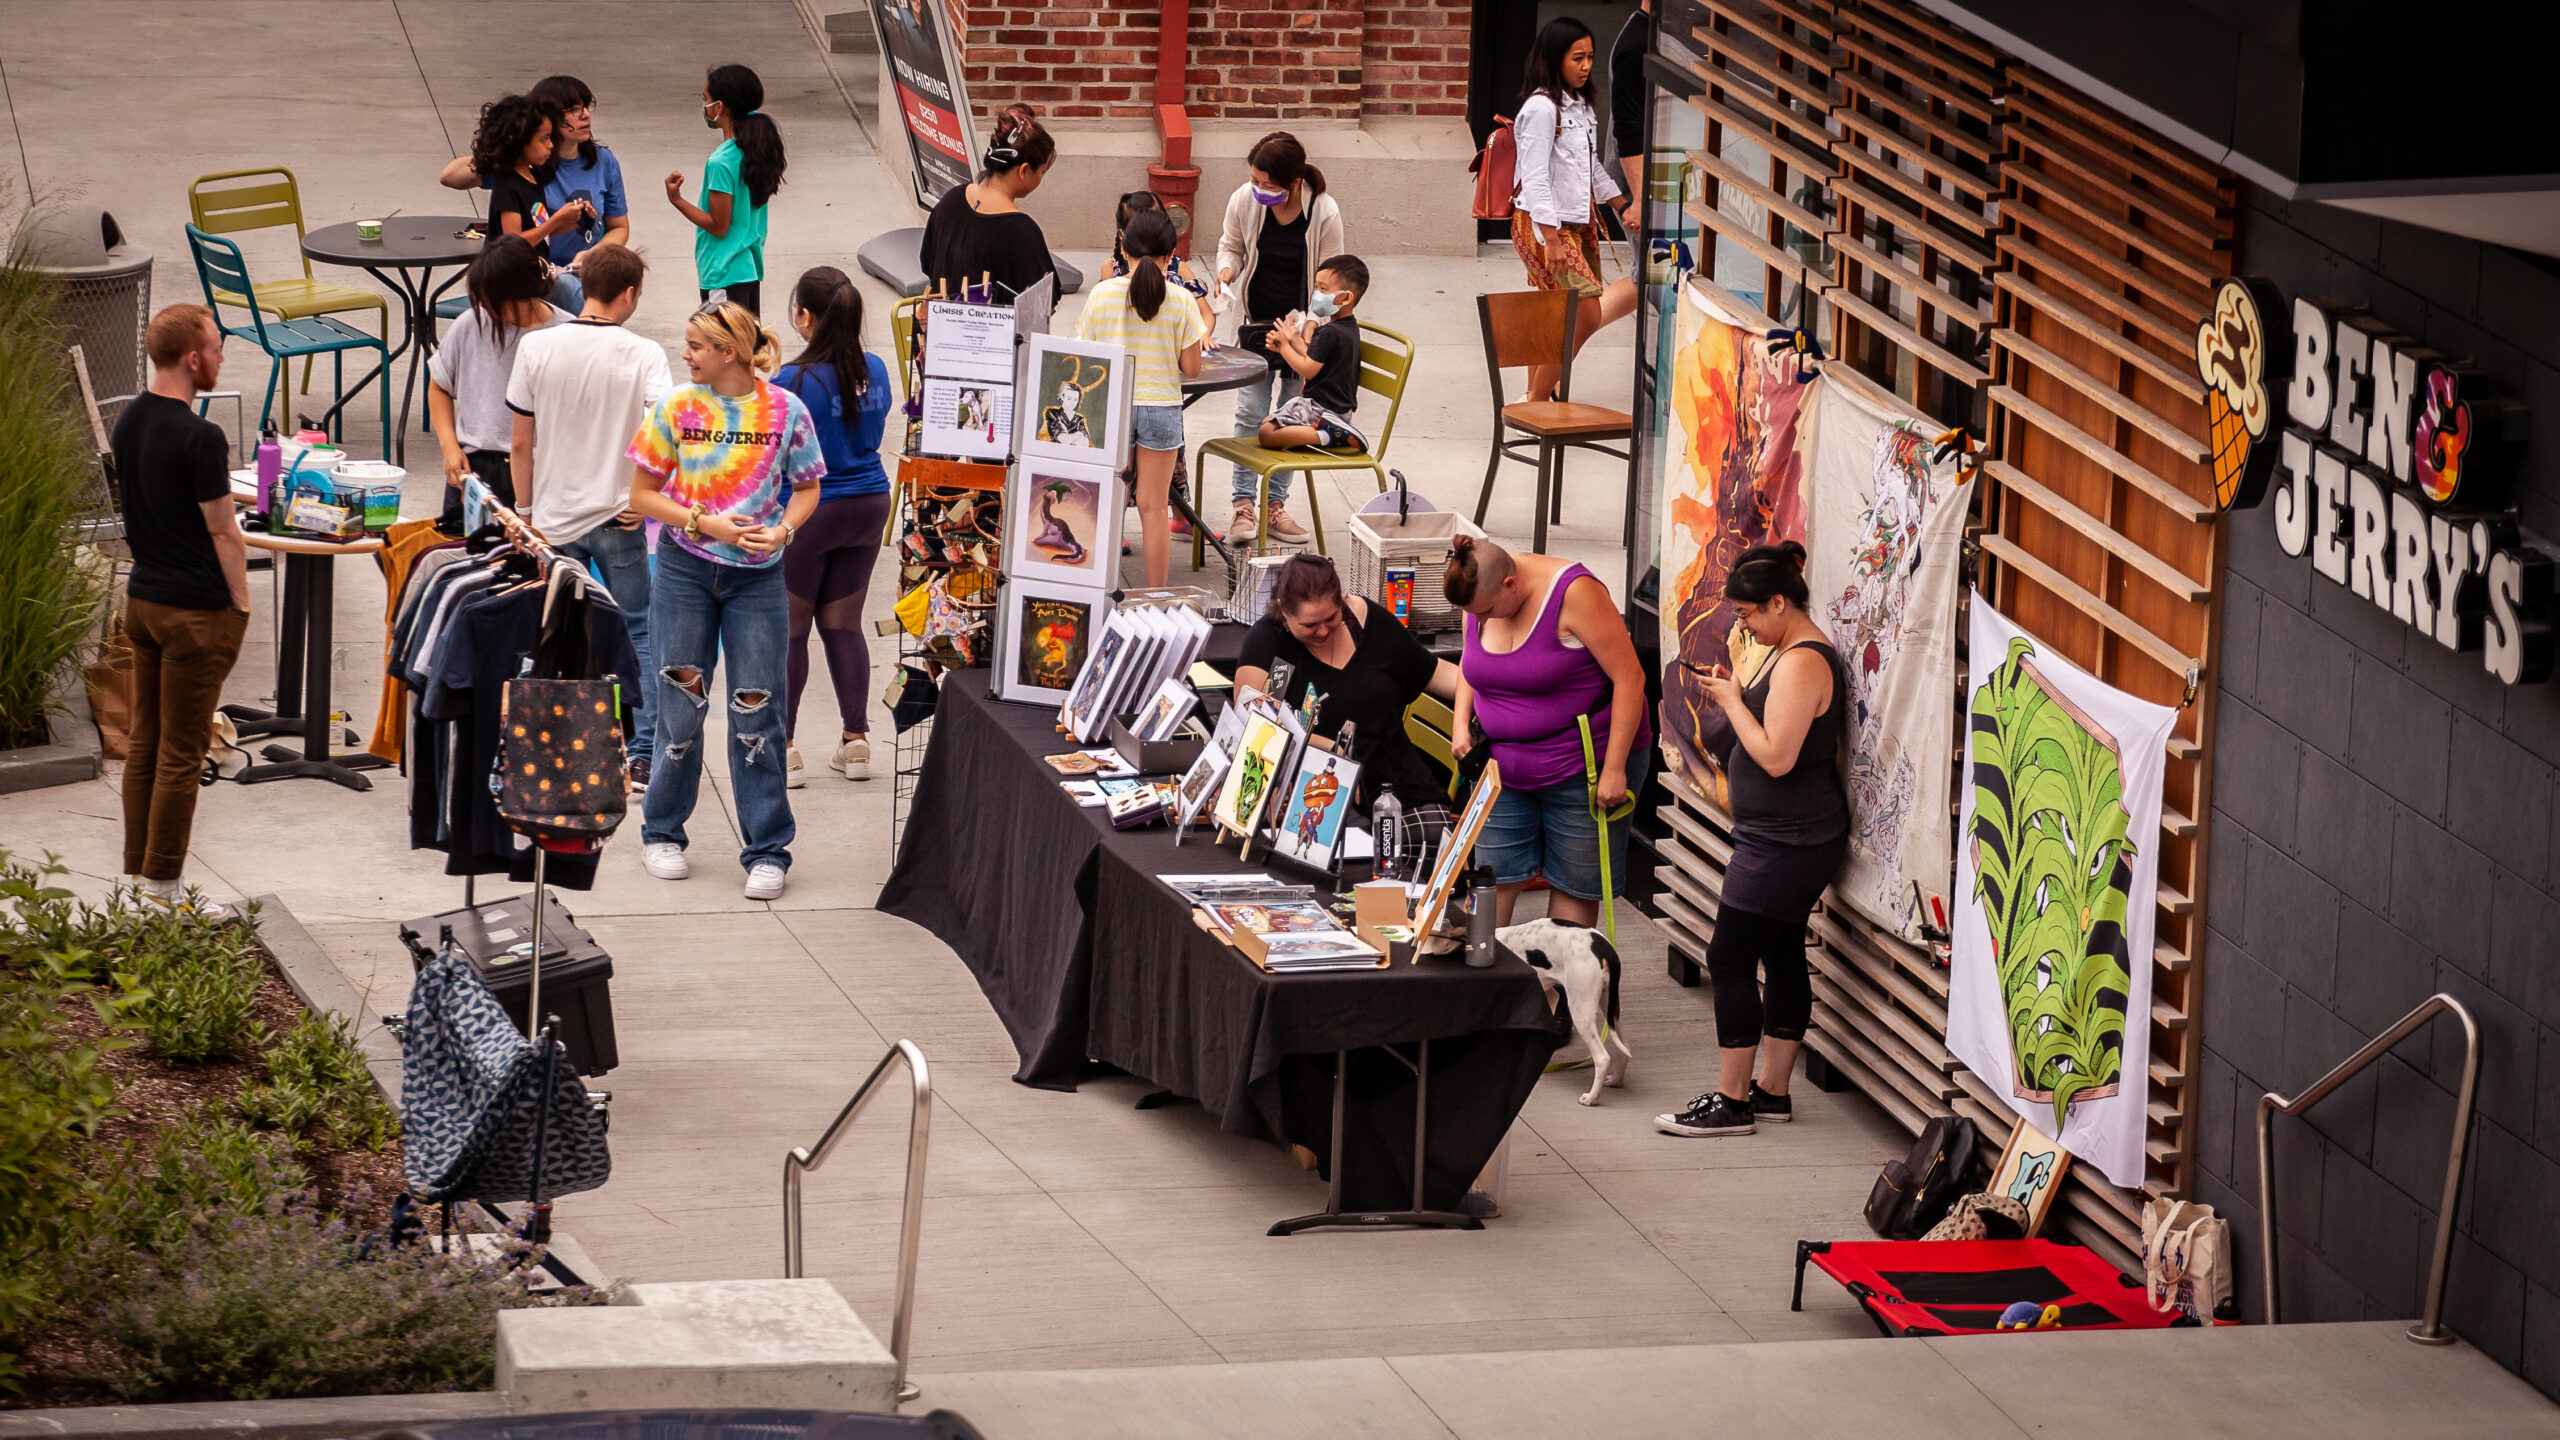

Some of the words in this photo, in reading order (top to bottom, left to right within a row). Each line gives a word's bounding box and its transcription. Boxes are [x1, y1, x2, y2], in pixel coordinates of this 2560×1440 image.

[893, 55, 915, 83] NOW
[914, 68, 950, 101] HIRING
[907, 110, 939, 143] WELCOME
[937, 131, 965, 156] BONUS
[918, 101, 938, 125] $250
[2288, 297, 2417, 486] BEN
[681, 427, 712, 442] BEN
[2274, 431, 2523, 686] JERRY'S
[1382, 818, 1391, 857] essentia
